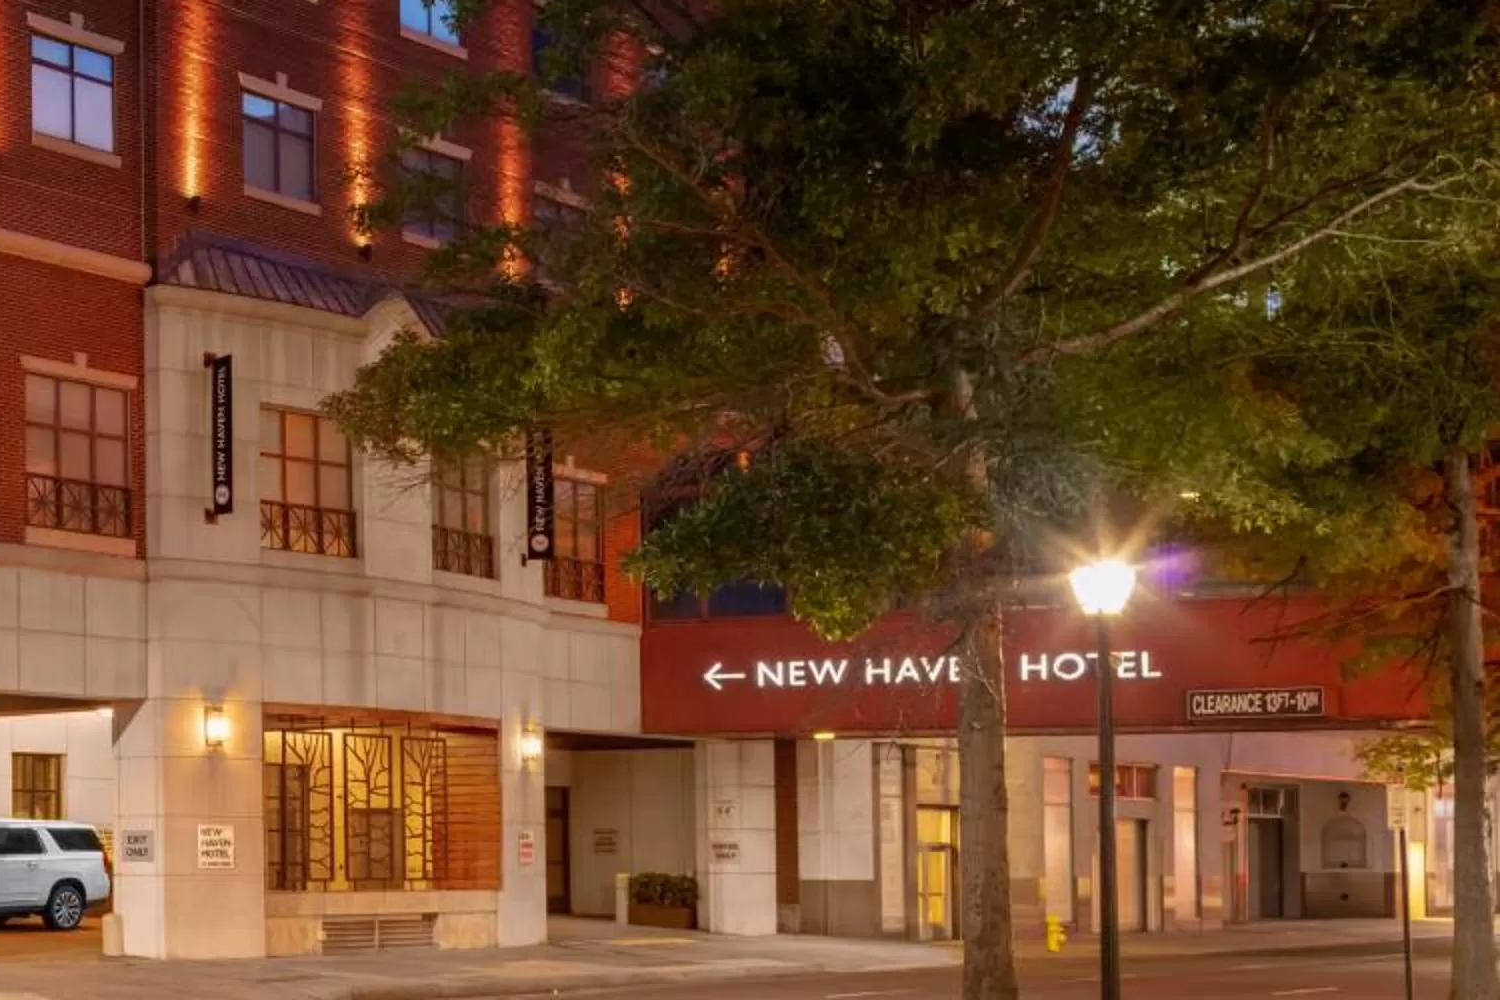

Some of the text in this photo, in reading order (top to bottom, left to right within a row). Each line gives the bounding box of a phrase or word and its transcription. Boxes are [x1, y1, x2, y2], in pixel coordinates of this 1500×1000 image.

[216, 452, 228, 481] NEW
[757, 659, 848, 687] NEW
[864, 656, 961, 685] HAVE
[1192, 693, 1263, 714] CLEARANCE
